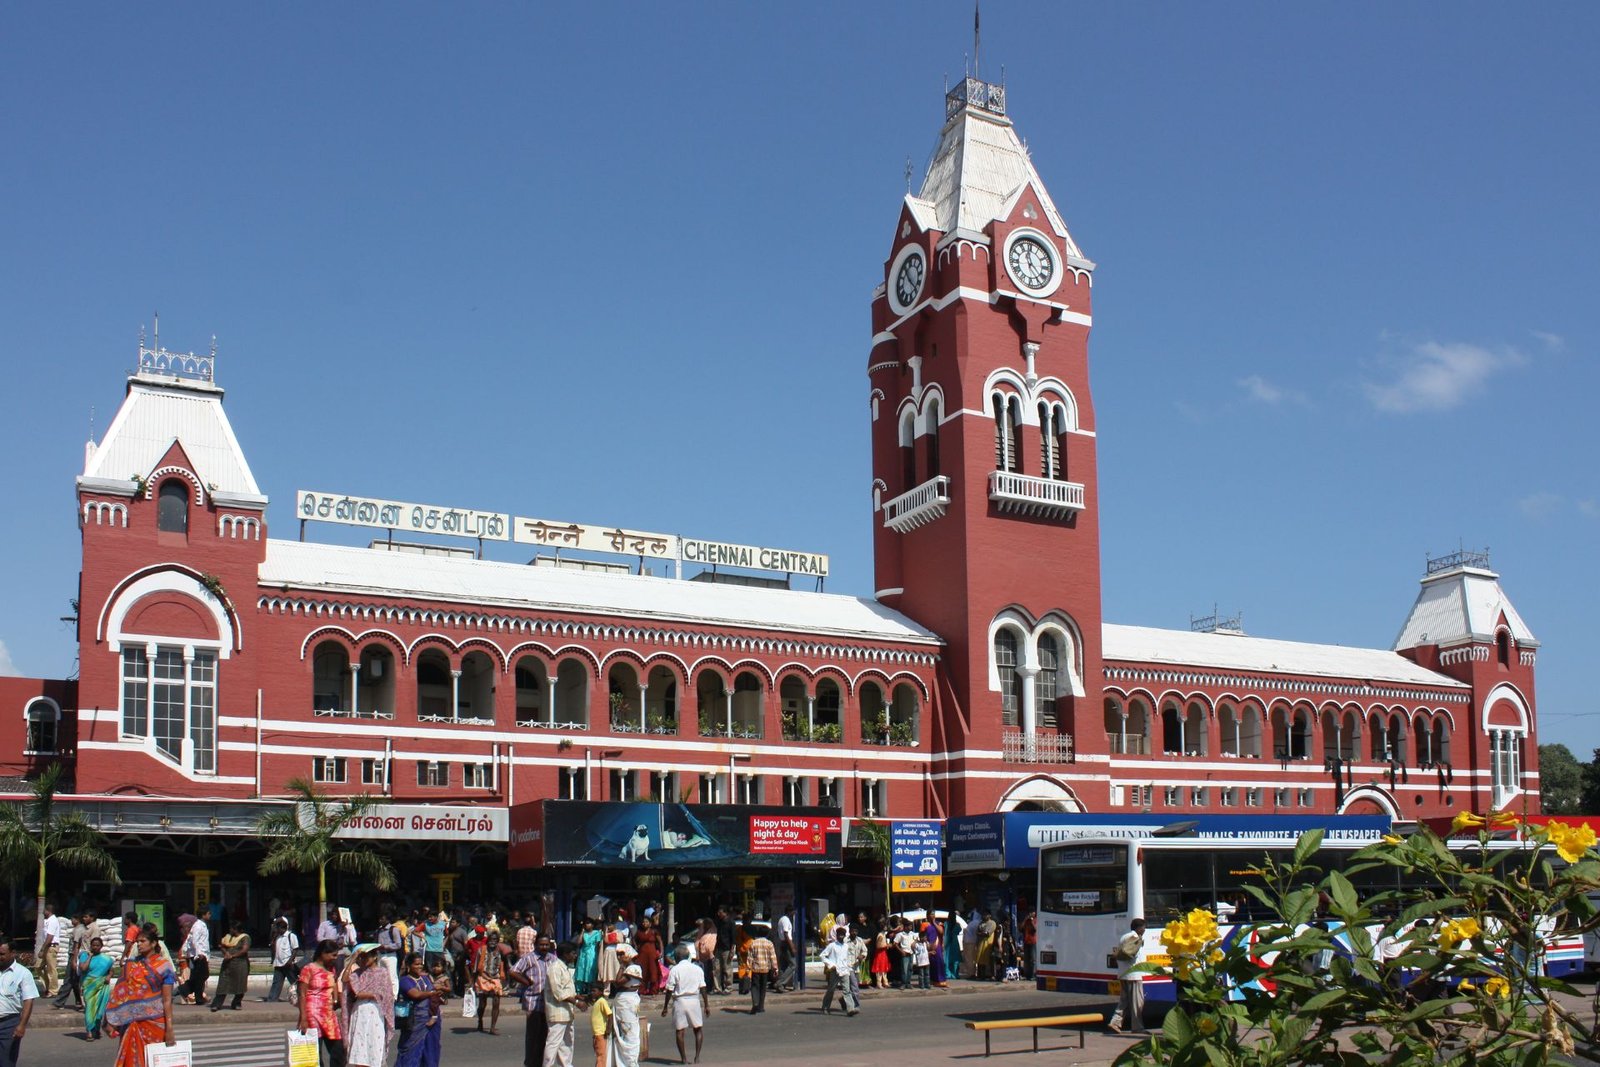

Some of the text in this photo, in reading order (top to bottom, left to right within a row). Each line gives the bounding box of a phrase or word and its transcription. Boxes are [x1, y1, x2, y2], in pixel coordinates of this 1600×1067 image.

[300, 493, 504, 537] சென்னை சென்ட்ரல்
[684, 541, 827, 575] CHENNAI CENTRAL
[411, 813, 493, 835] சென்ட்ரல்
[753, 819, 808, 829] Happy to help
[517, 829, 540, 843] vodafone
[753, 829, 799, 839] night & day
[1037, 830, 1154, 842] THE HIND
[1328, 829, 1381, 839] NEWSPAPER
[1082, 849, 1093, 859] A1
